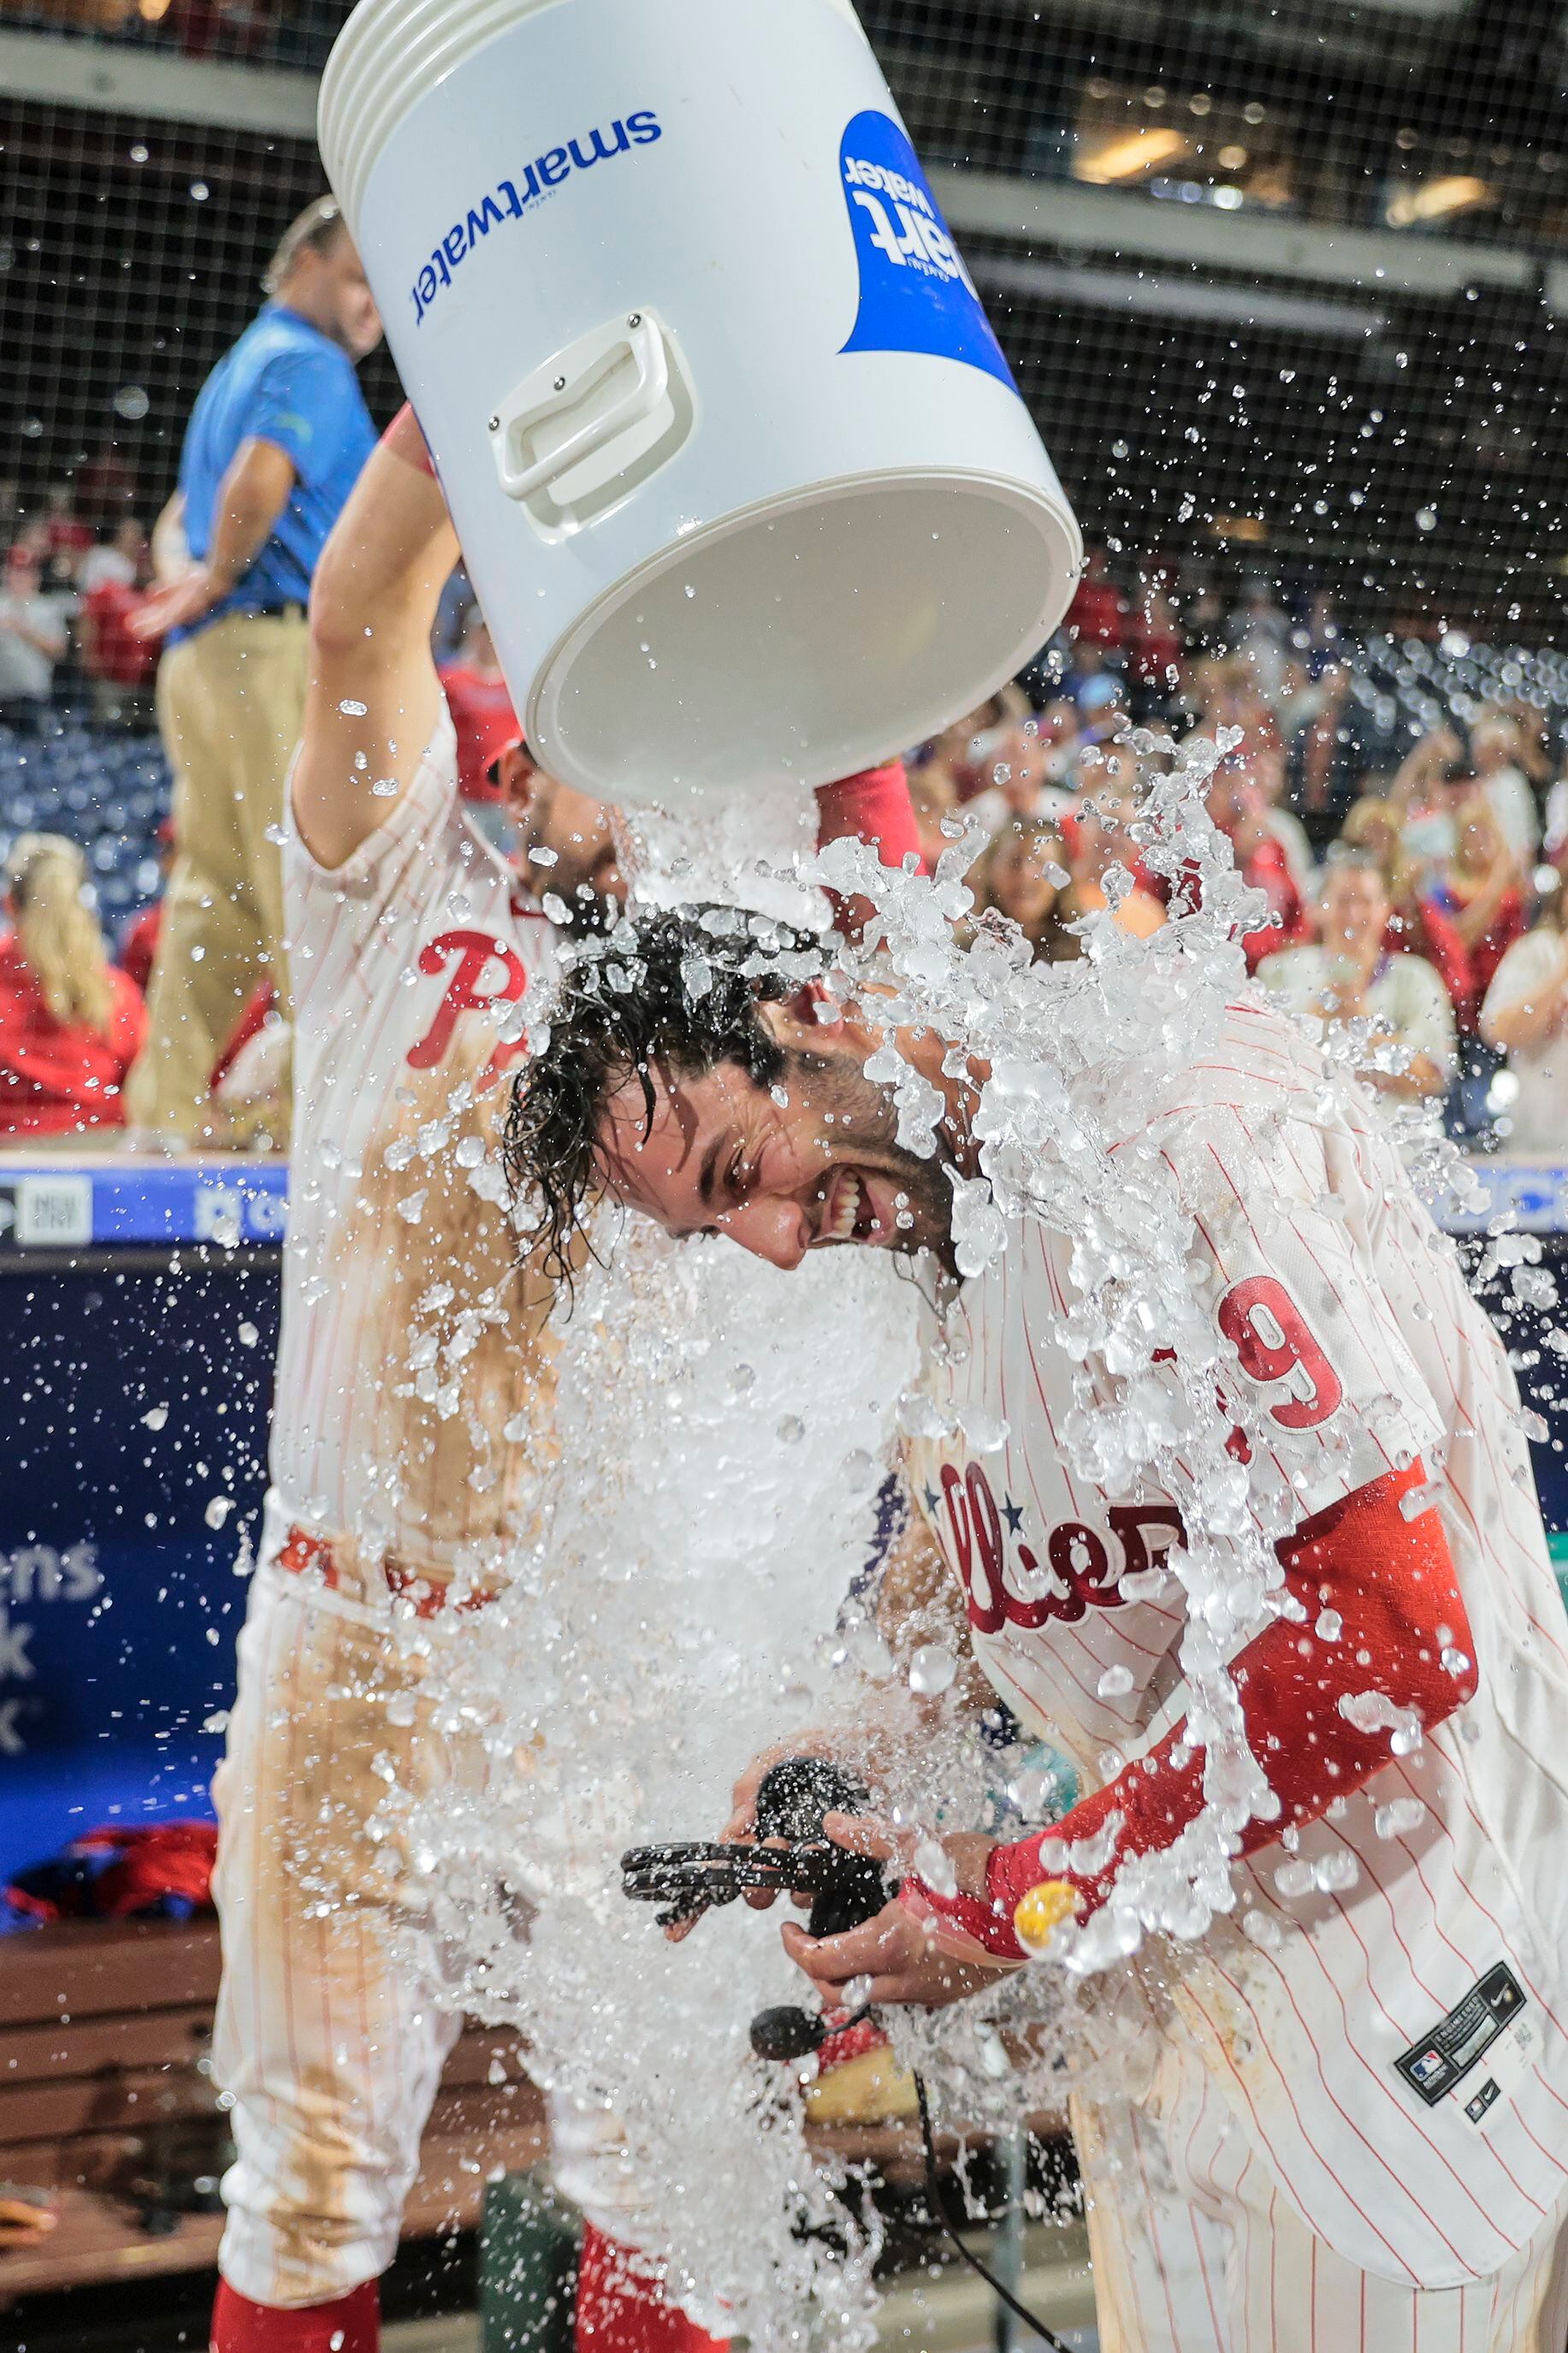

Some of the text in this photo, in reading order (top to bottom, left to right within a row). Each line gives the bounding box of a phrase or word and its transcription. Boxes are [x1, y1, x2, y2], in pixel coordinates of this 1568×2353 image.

[411, 110, 662, 329] smartwater
[844, 156, 936, 220] water
[852, 190, 975, 295] art
[405, 929, 530, 1087] P
